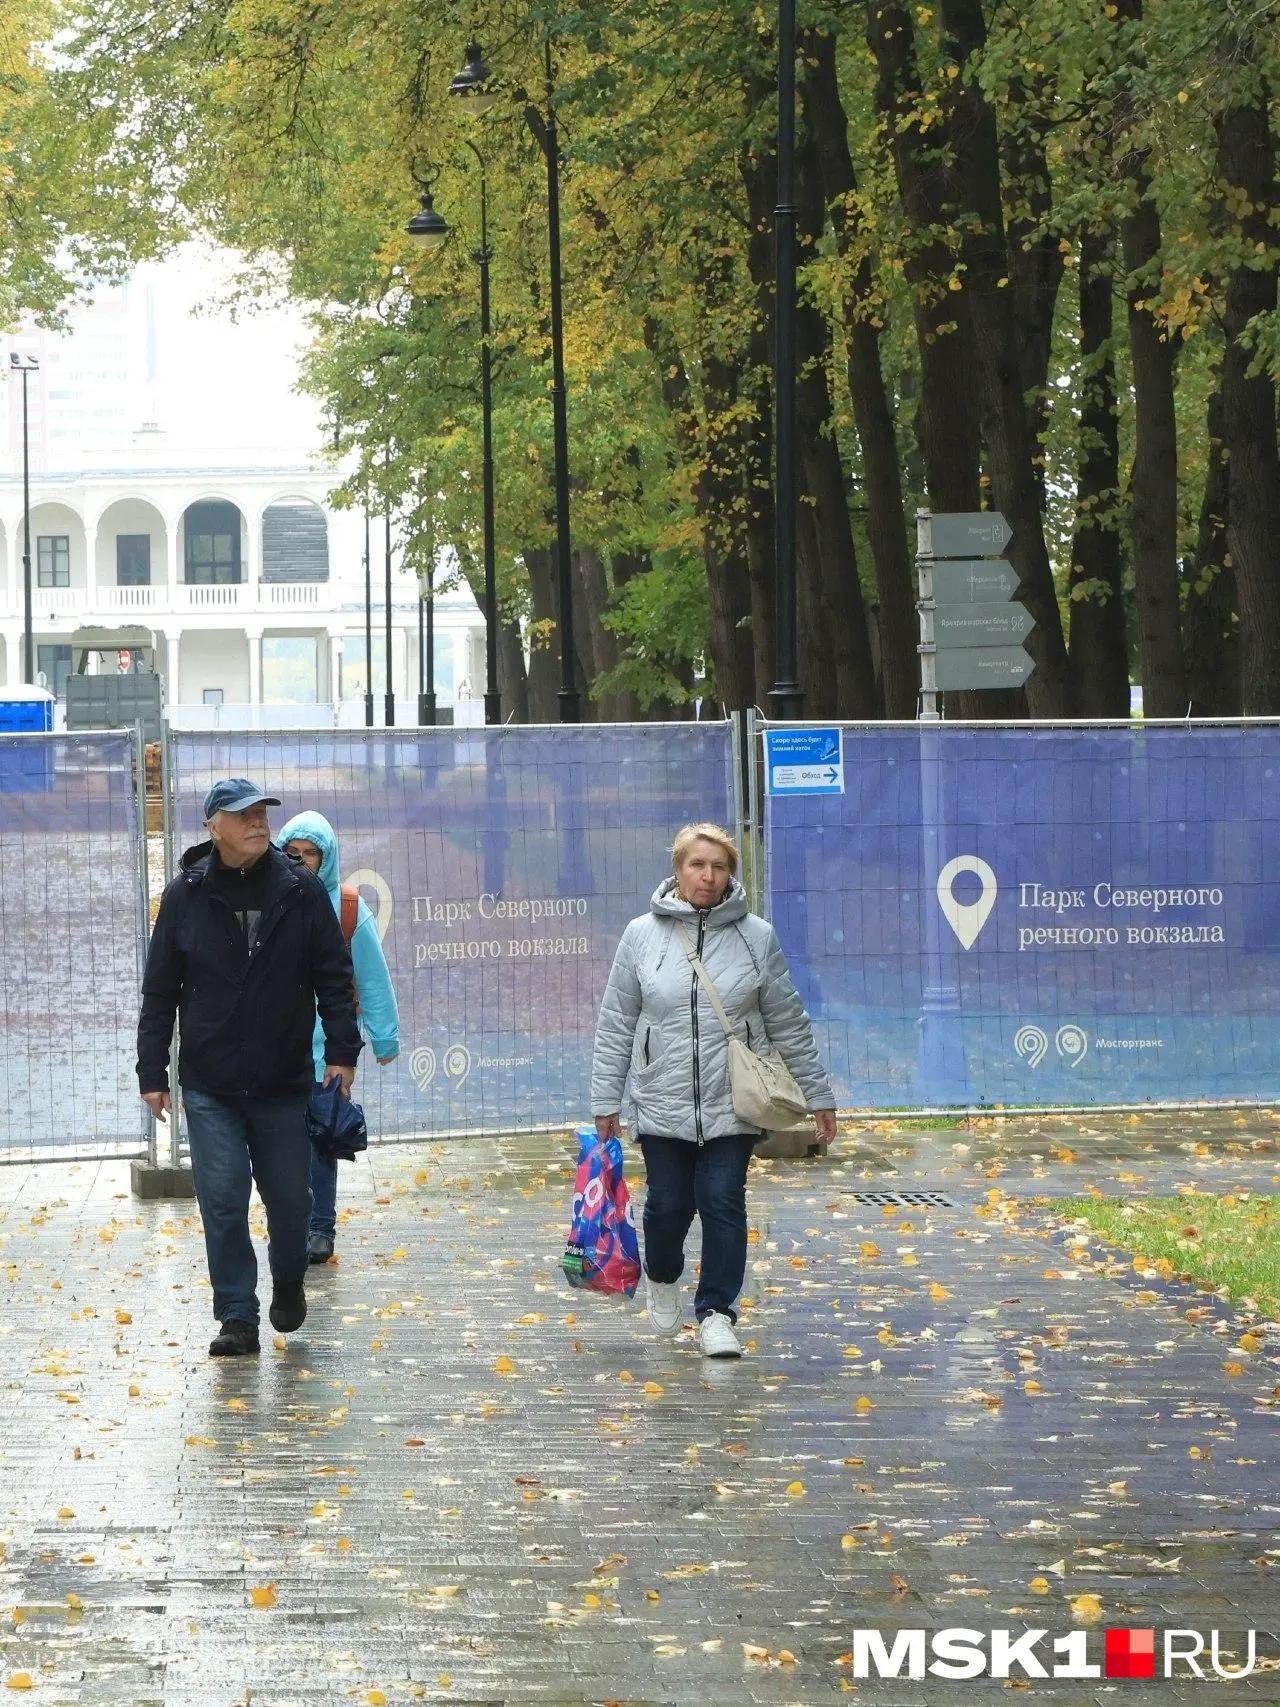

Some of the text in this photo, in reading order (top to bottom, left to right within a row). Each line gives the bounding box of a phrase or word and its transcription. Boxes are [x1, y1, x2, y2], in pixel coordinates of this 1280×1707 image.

[801, 771, 821, 779] Обход
[411, 892, 588, 927] Парк Северного
[1018, 882, 1224, 914] Парк Северного
[1018, 924, 1226, 951] речного вокзала
[414, 936, 590, 968] речного вокзала
[1094, 1037, 1164, 1050] Мосгортранс
[476, 1054, 535, 1068] Мосгортранс
